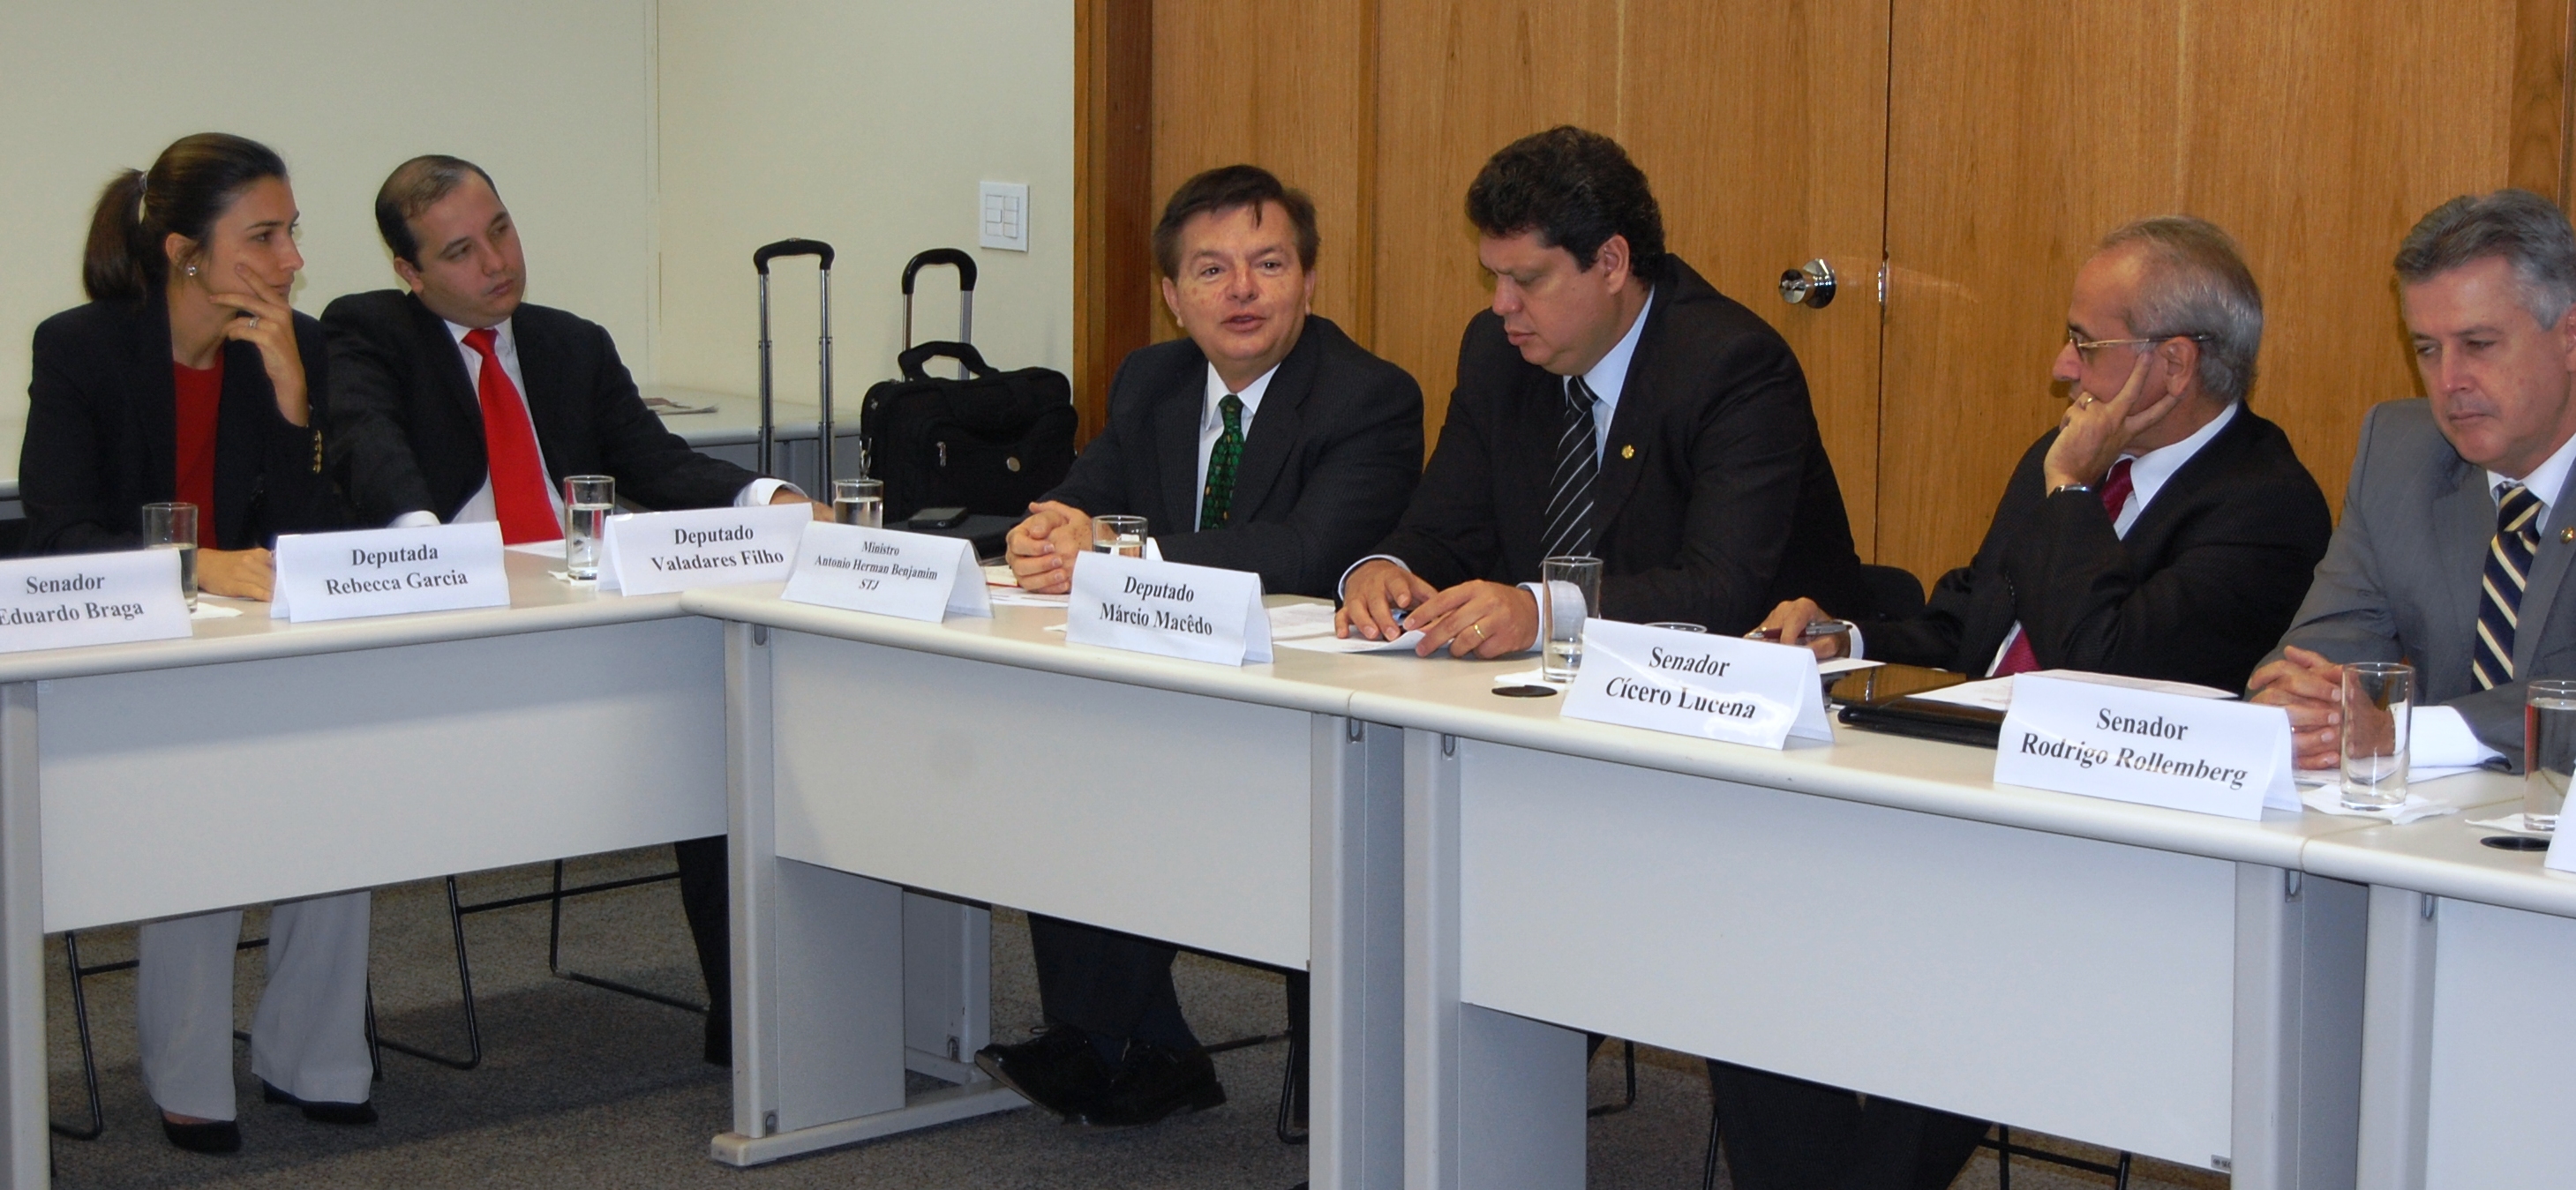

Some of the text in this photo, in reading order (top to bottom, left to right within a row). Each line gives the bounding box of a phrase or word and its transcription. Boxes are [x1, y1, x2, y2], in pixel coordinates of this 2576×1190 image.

[674, 525, 754, 548] Deputado
[861, 541, 900, 556] Ministro
[351, 544, 439, 569] Deputada
[650, 549, 785, 572] Valadares Filho
[815, 555, 938, 580] Antonio Herman Benjamim
[26, 573, 106, 595] Senador
[326, 570, 469, 595] Rebecca Garcia
[859, 578, 880, 590] STJ
[1123, 575, 1195, 602] Deputado
[0, 602, 145, 626] Eduardo Braga
[1100, 602, 1213, 635] Márcio Macêdo
[1648, 647, 1731, 677] Senador
[1605, 677, 1756, 719] Cícero Lucena
[2095, 707, 2189, 741] Senador
[2019, 732, 2248, 790] Rodrigo Rollemberg
